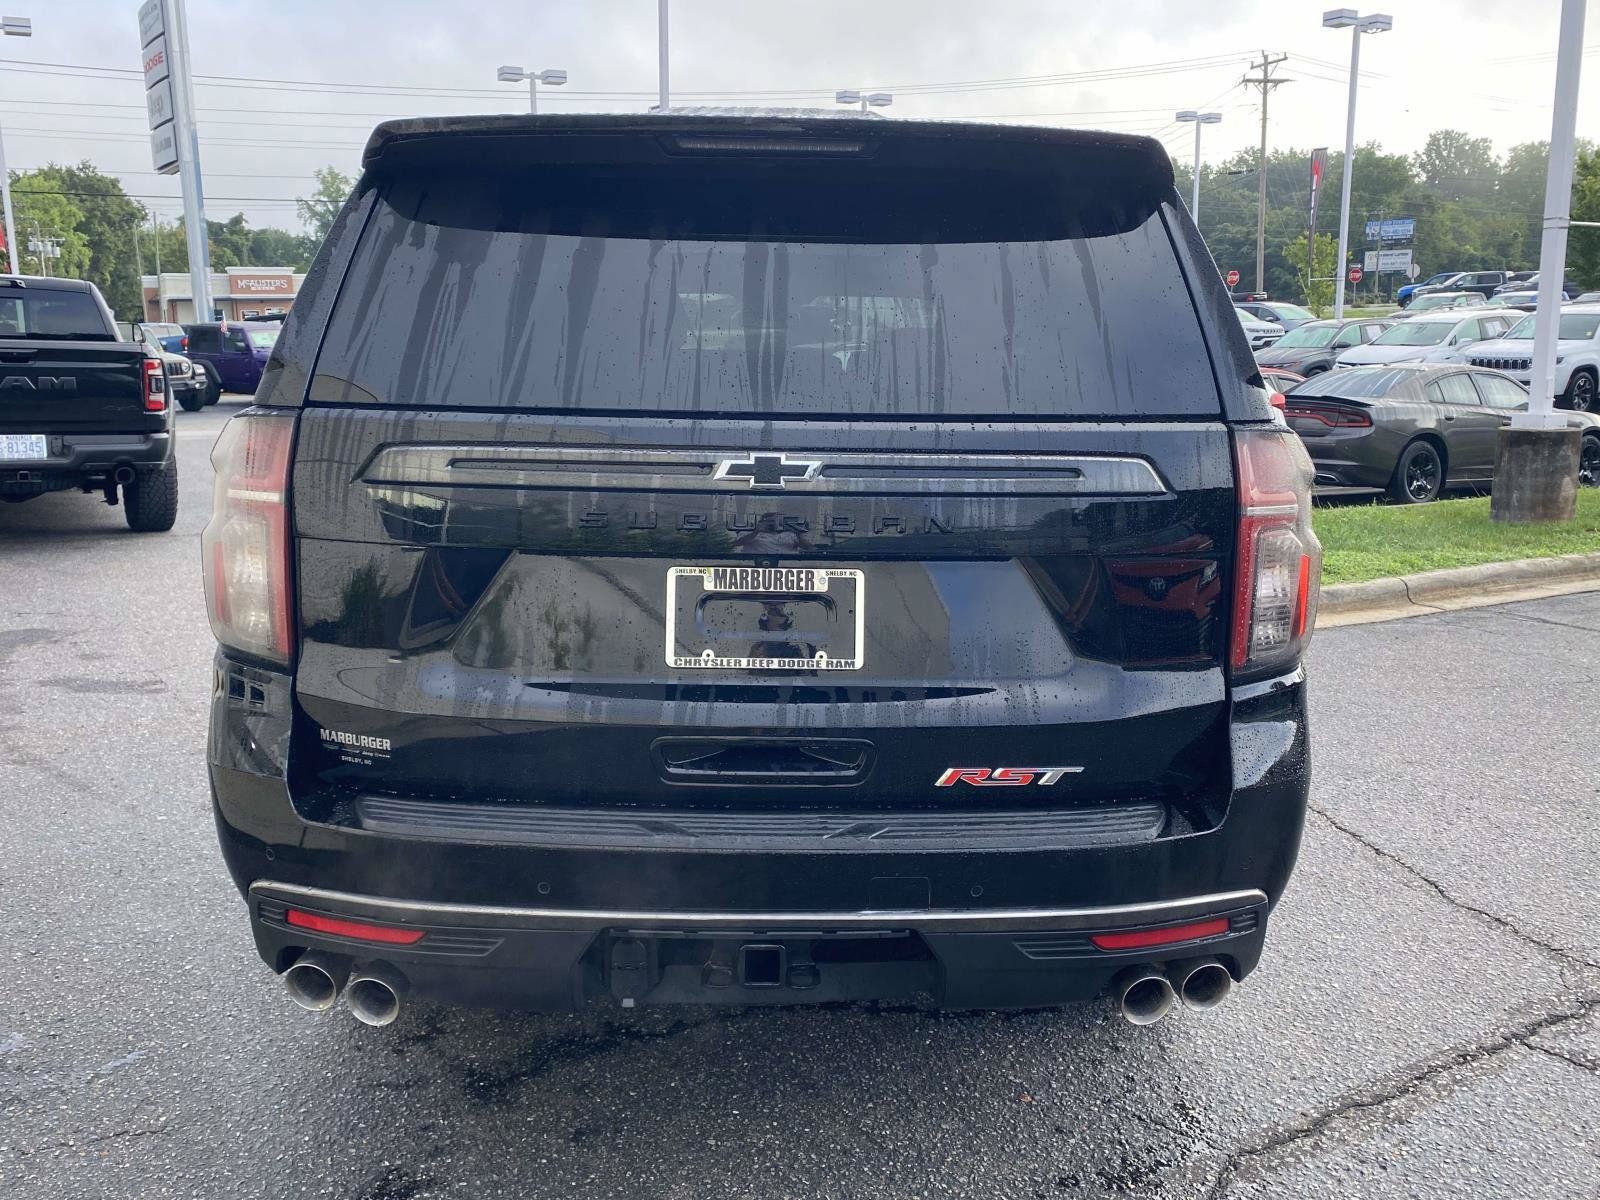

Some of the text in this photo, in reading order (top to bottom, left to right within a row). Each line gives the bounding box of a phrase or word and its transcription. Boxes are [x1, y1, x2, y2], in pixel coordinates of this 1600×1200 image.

[0, 376, 77, 390] AM
[578, 511, 956, 534] SUBURBAN
[713, 568, 815, 591] MARBURGER
[673, 658, 856, 669] CHRYSLER JEEP DODGE RAM
[320, 728, 391, 751] MARBURGER
[934, 766, 1086, 787] RST
